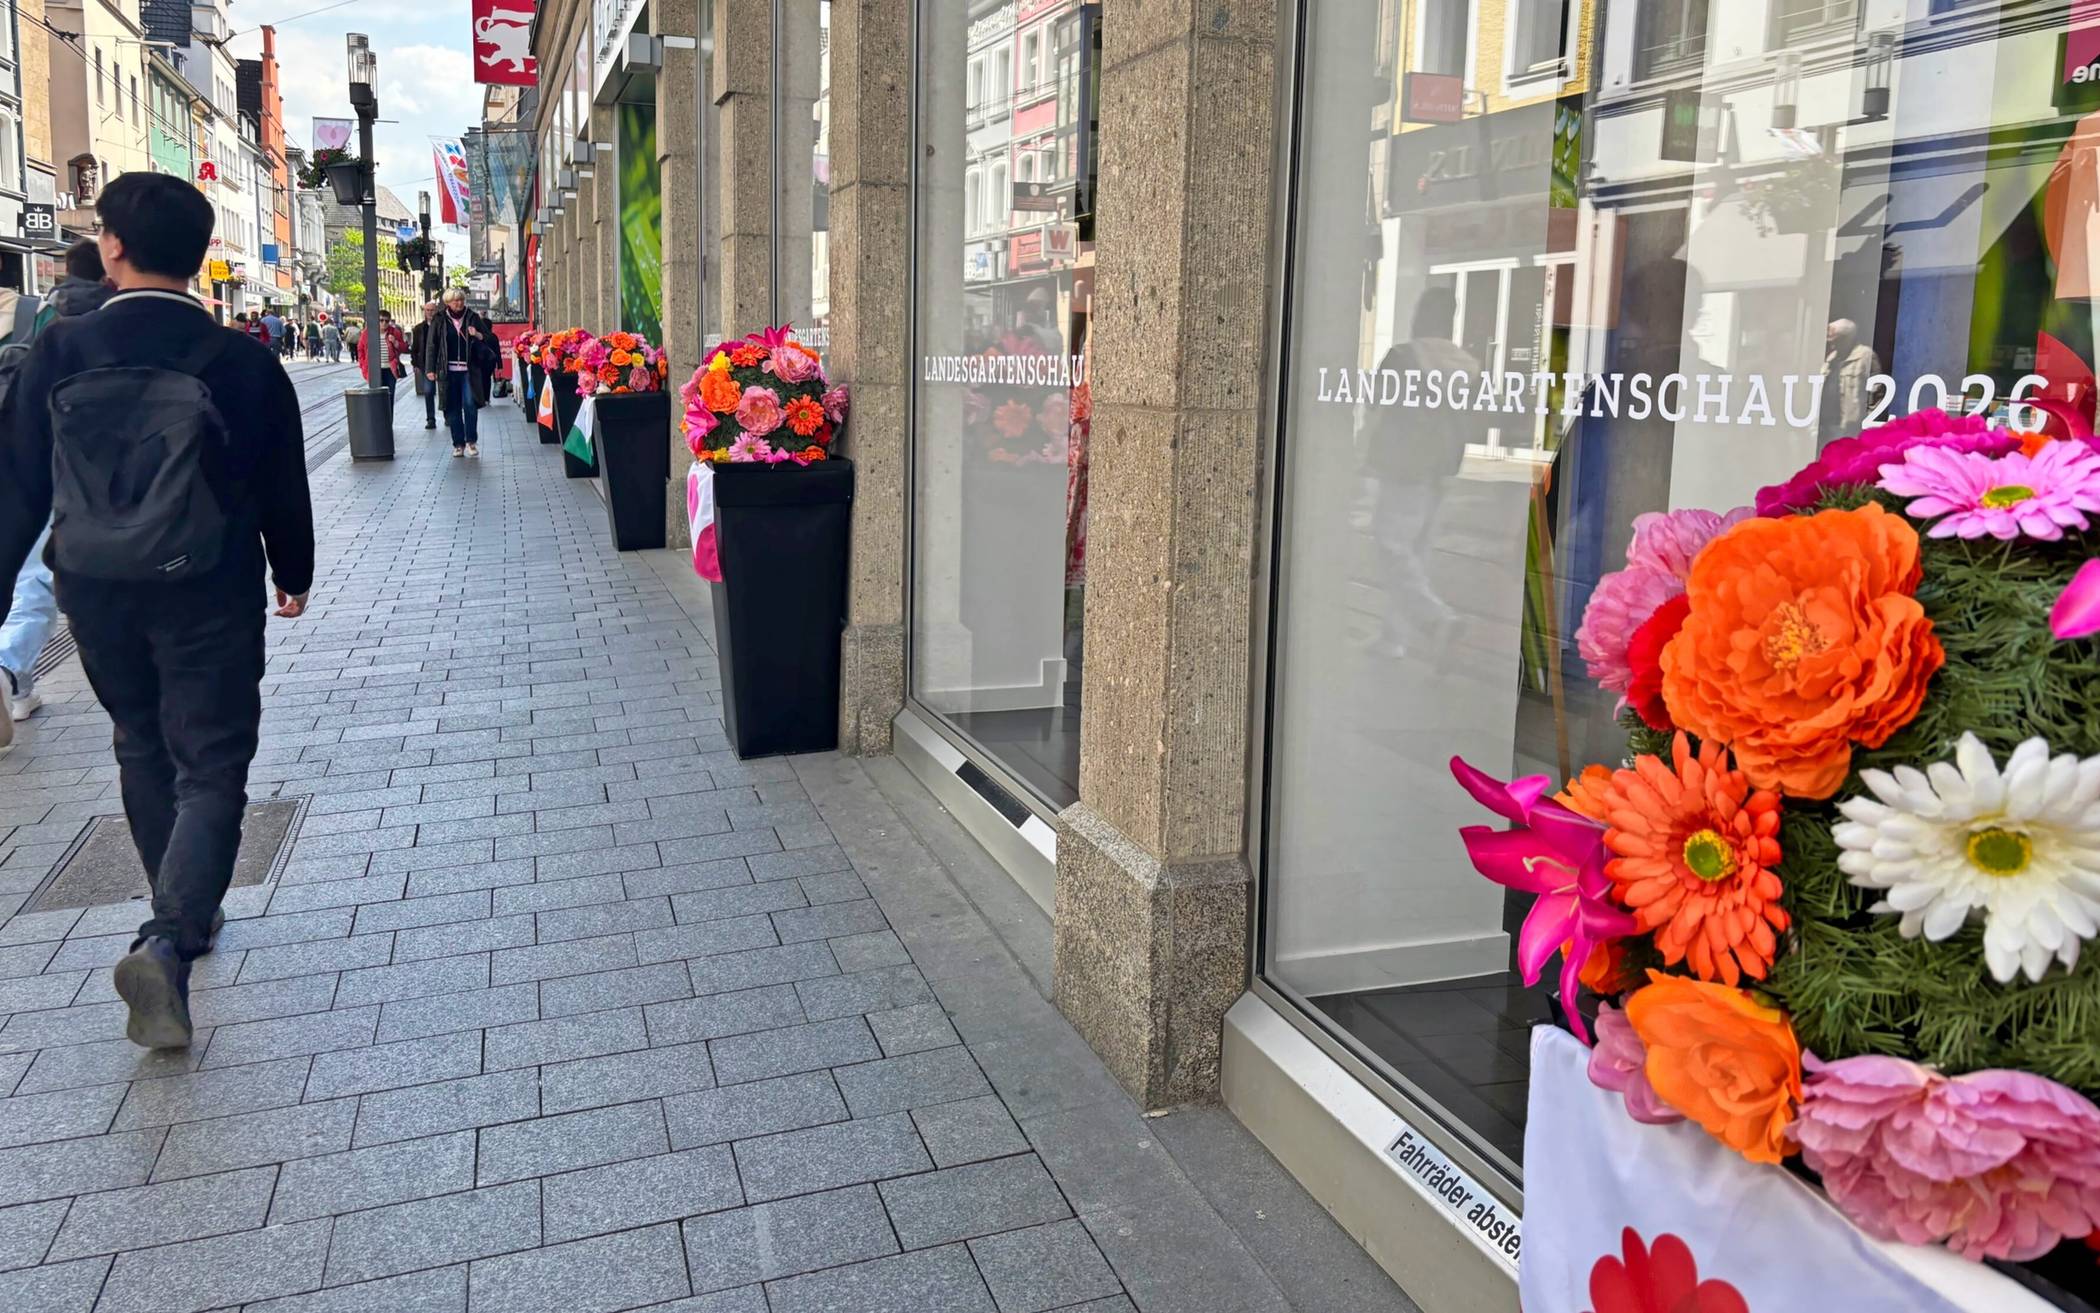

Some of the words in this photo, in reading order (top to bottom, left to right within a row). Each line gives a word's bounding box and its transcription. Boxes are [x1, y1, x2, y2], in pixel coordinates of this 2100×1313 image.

[924, 355, 1084, 387] LANDESGARTENSCHAU
[1318, 368, 1825, 428] LANDESGARTENSCHAU
[1861, 374, 2049, 435] 2026
[1390, 1131, 1474, 1208] Fahrräder
